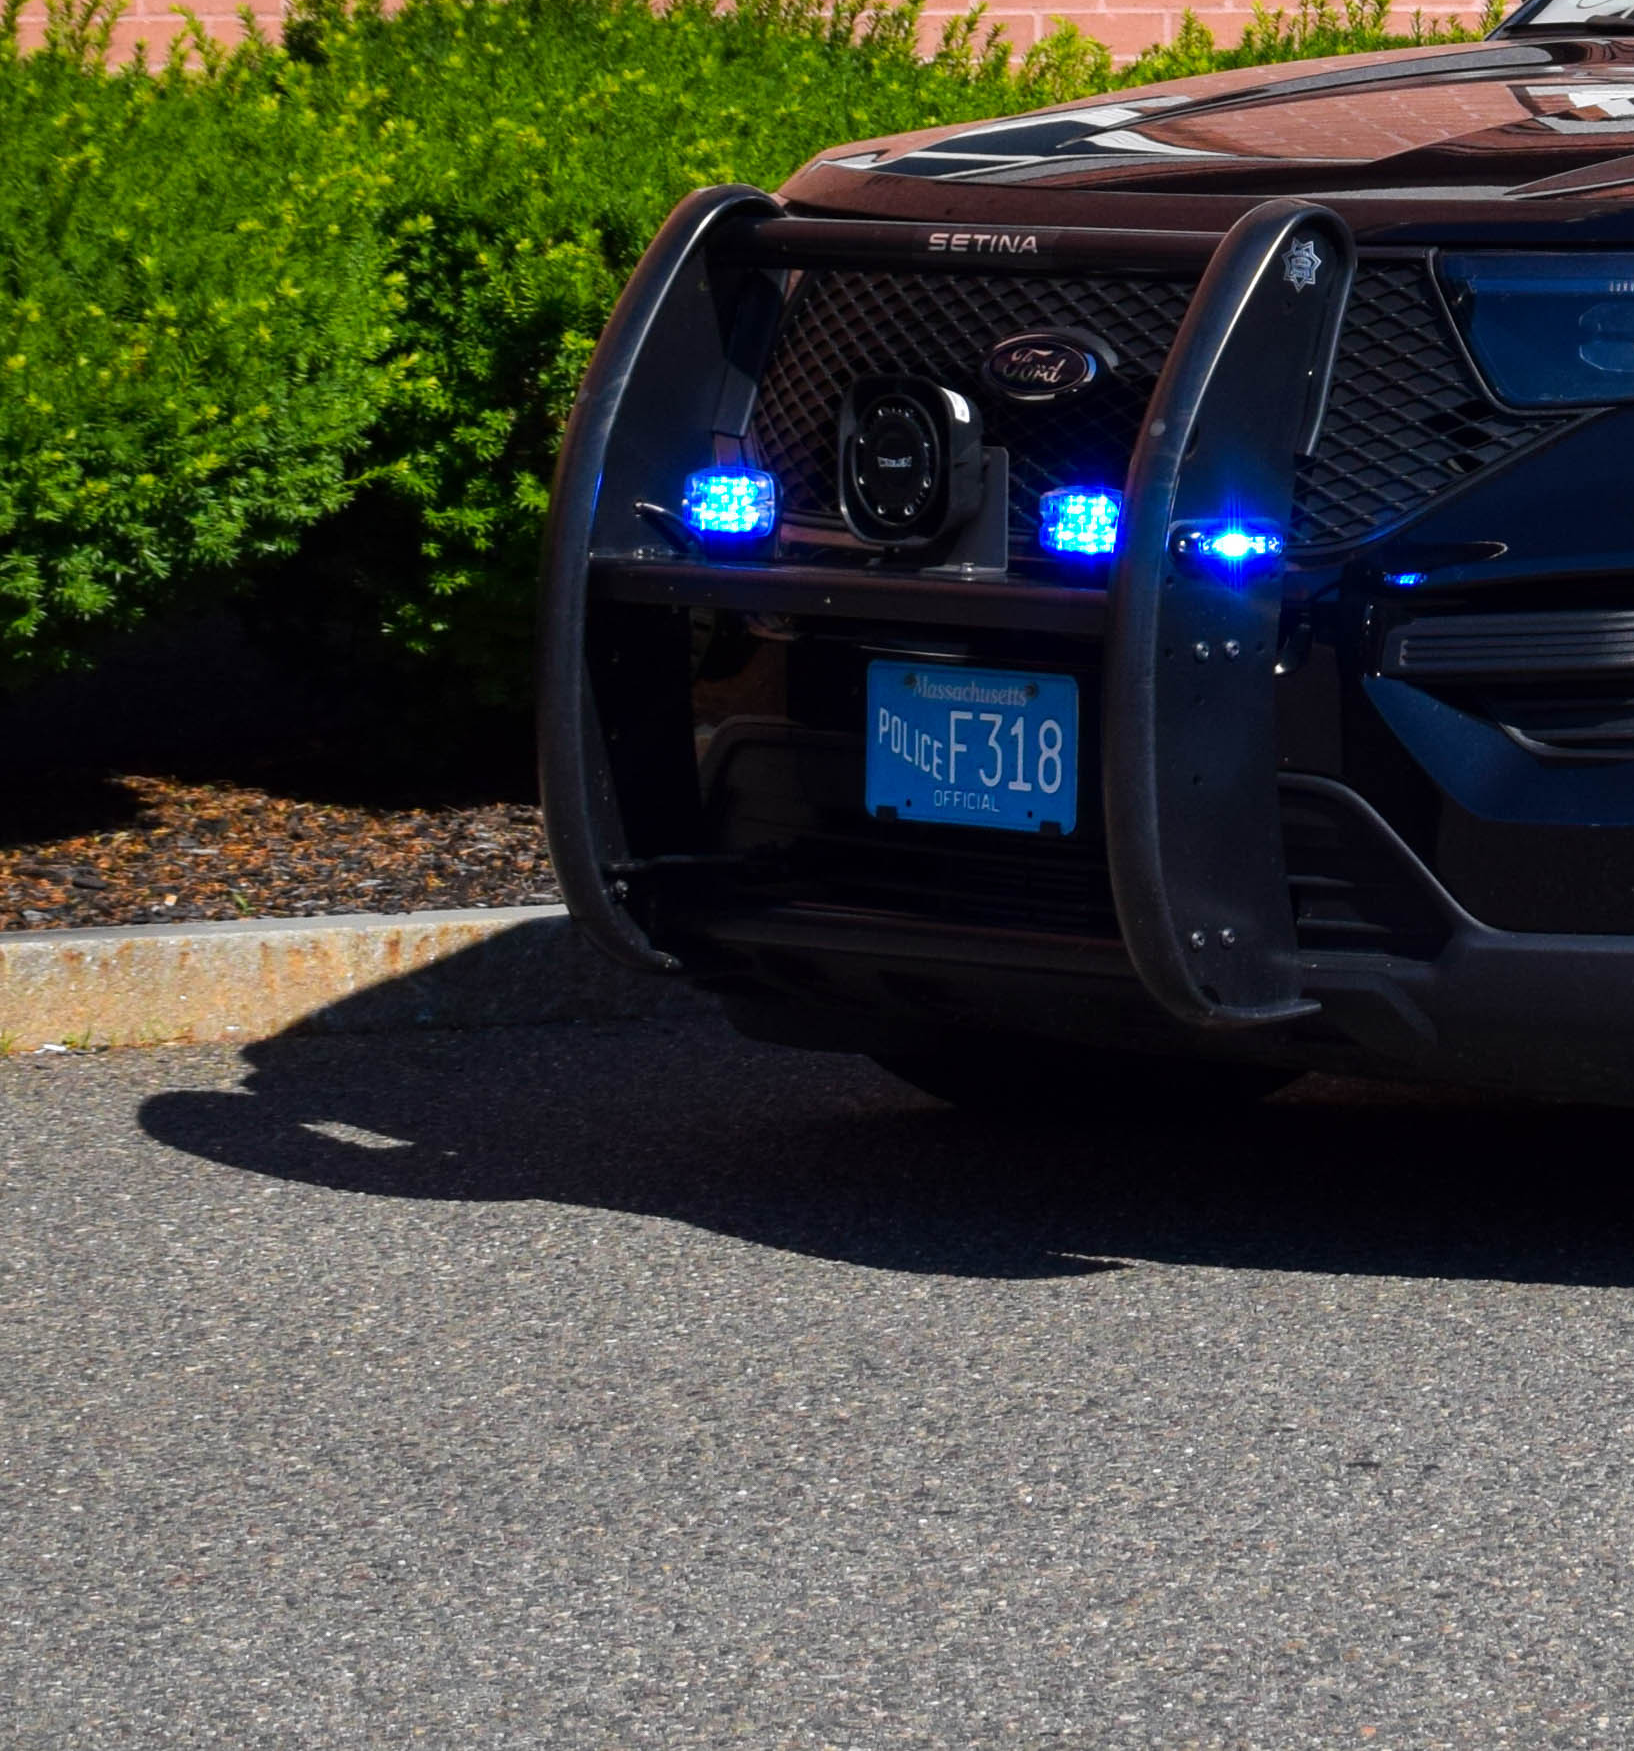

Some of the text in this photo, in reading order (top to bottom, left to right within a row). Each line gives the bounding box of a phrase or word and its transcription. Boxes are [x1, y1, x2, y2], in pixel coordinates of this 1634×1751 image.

[927, 232, 1039, 254] SETINA
[1002, 348, 1067, 384] Ford
[913, 674, 1027, 707] Massachusetts
[878, 707, 1063, 794] POLICE F318
[933, 789, 1001, 813] OFFICIAL
